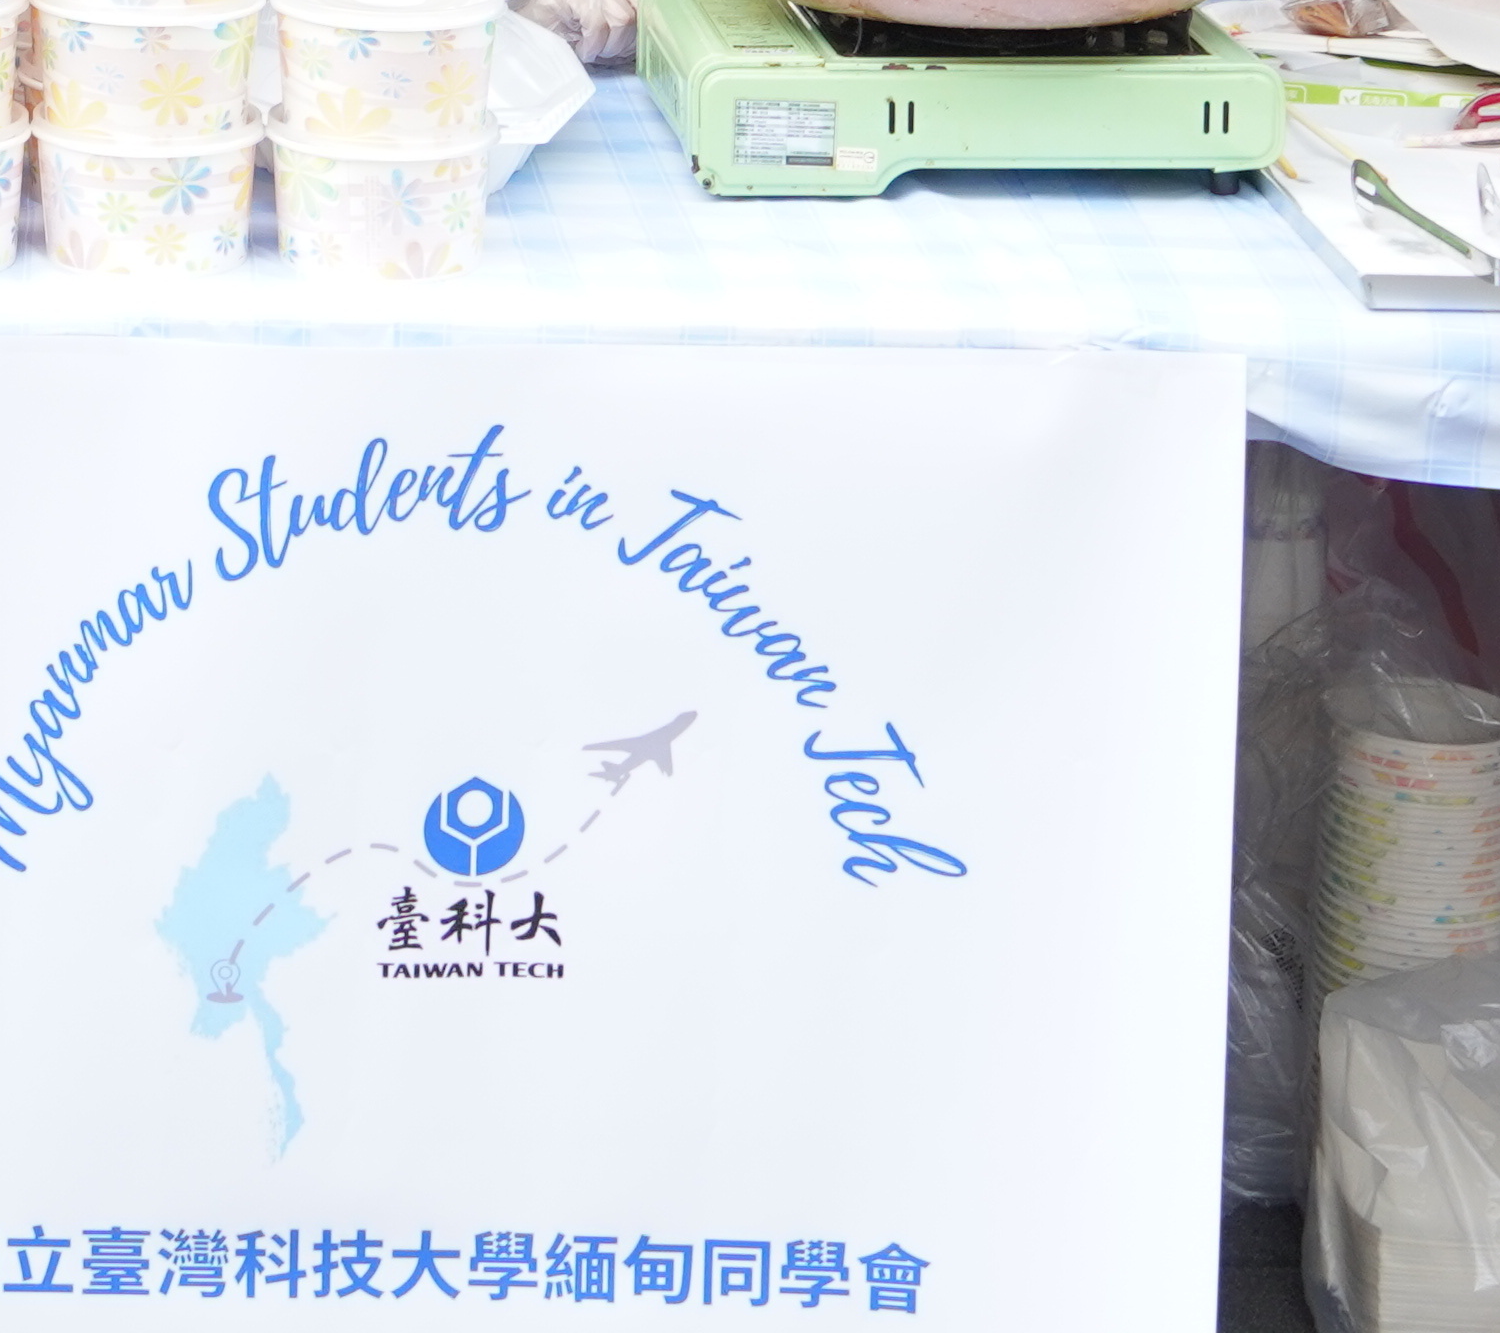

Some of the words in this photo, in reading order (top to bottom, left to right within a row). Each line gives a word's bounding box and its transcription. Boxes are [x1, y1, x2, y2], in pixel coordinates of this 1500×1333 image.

[207, 424, 532, 582] Students
[545, 465, 615, 531] in
[616, 487, 837, 711] Taiwan
[804, 720, 969, 889] Tech
[376, 886, 564, 957] 臺科大
[376, 961, 485, 981] TAIWAN
[493, 960, 565, 981] TECH
